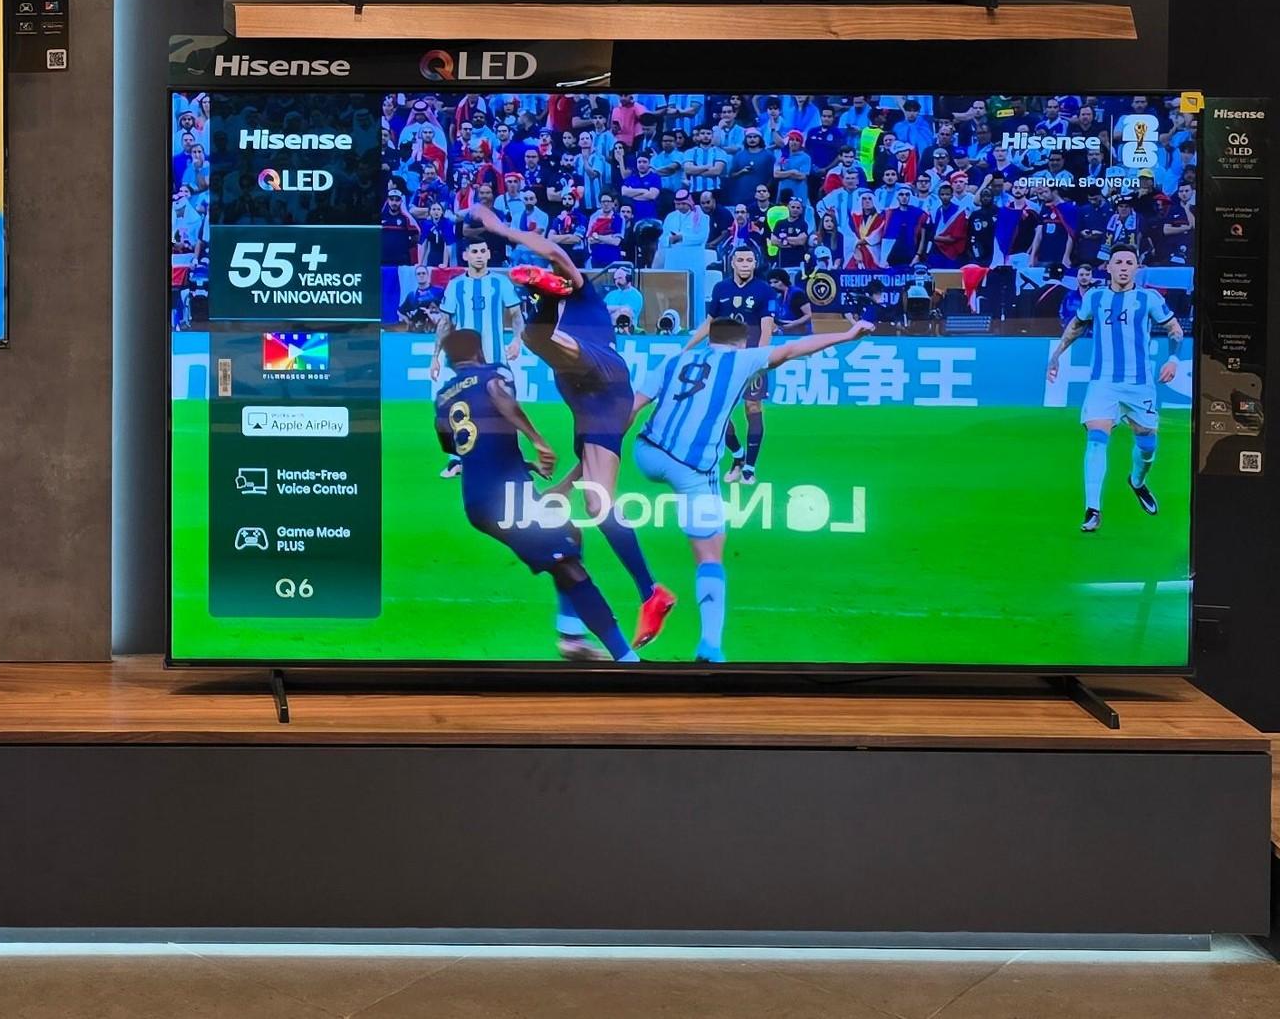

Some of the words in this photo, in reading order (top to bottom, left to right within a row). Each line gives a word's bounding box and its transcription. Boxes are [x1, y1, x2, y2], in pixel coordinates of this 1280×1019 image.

[214, 54, 351, 77] Hisense
[419, 49, 538, 81] QLED
[1213, 109, 1265, 119] Hisense
[239, 129, 353, 150] Hisense
[1001, 132, 1102, 150] Hisense
[1228, 133, 1249, 145] Q6
[257, 168, 333, 191] QLED
[1019, 177, 1075, 188] OFFICIAL
[1078, 177, 1141, 188] SPONSOR
[228, 242, 328, 288] 55+
[298, 273, 341, 287] YEARS
[342, 273, 362, 287] OF
[251, 290, 270, 304] TV
[273, 290, 363, 304] INNOVATION
[1104, 309, 1128, 326] 24
[673, 362, 712, 402] 9
[271, 420, 303, 431] Apple
[305, 420, 344, 431] AirPlay
[449, 401, 478, 456] 8
[277, 469, 347, 481] Hands-Free
[277, 483, 310, 495] Voice
[312, 483, 358, 495] Control
[277, 526, 315, 538] Game
[316, 526, 351, 538] Mode
[277, 540, 305, 552] PLUS
[275, 578, 314, 598] Q6
